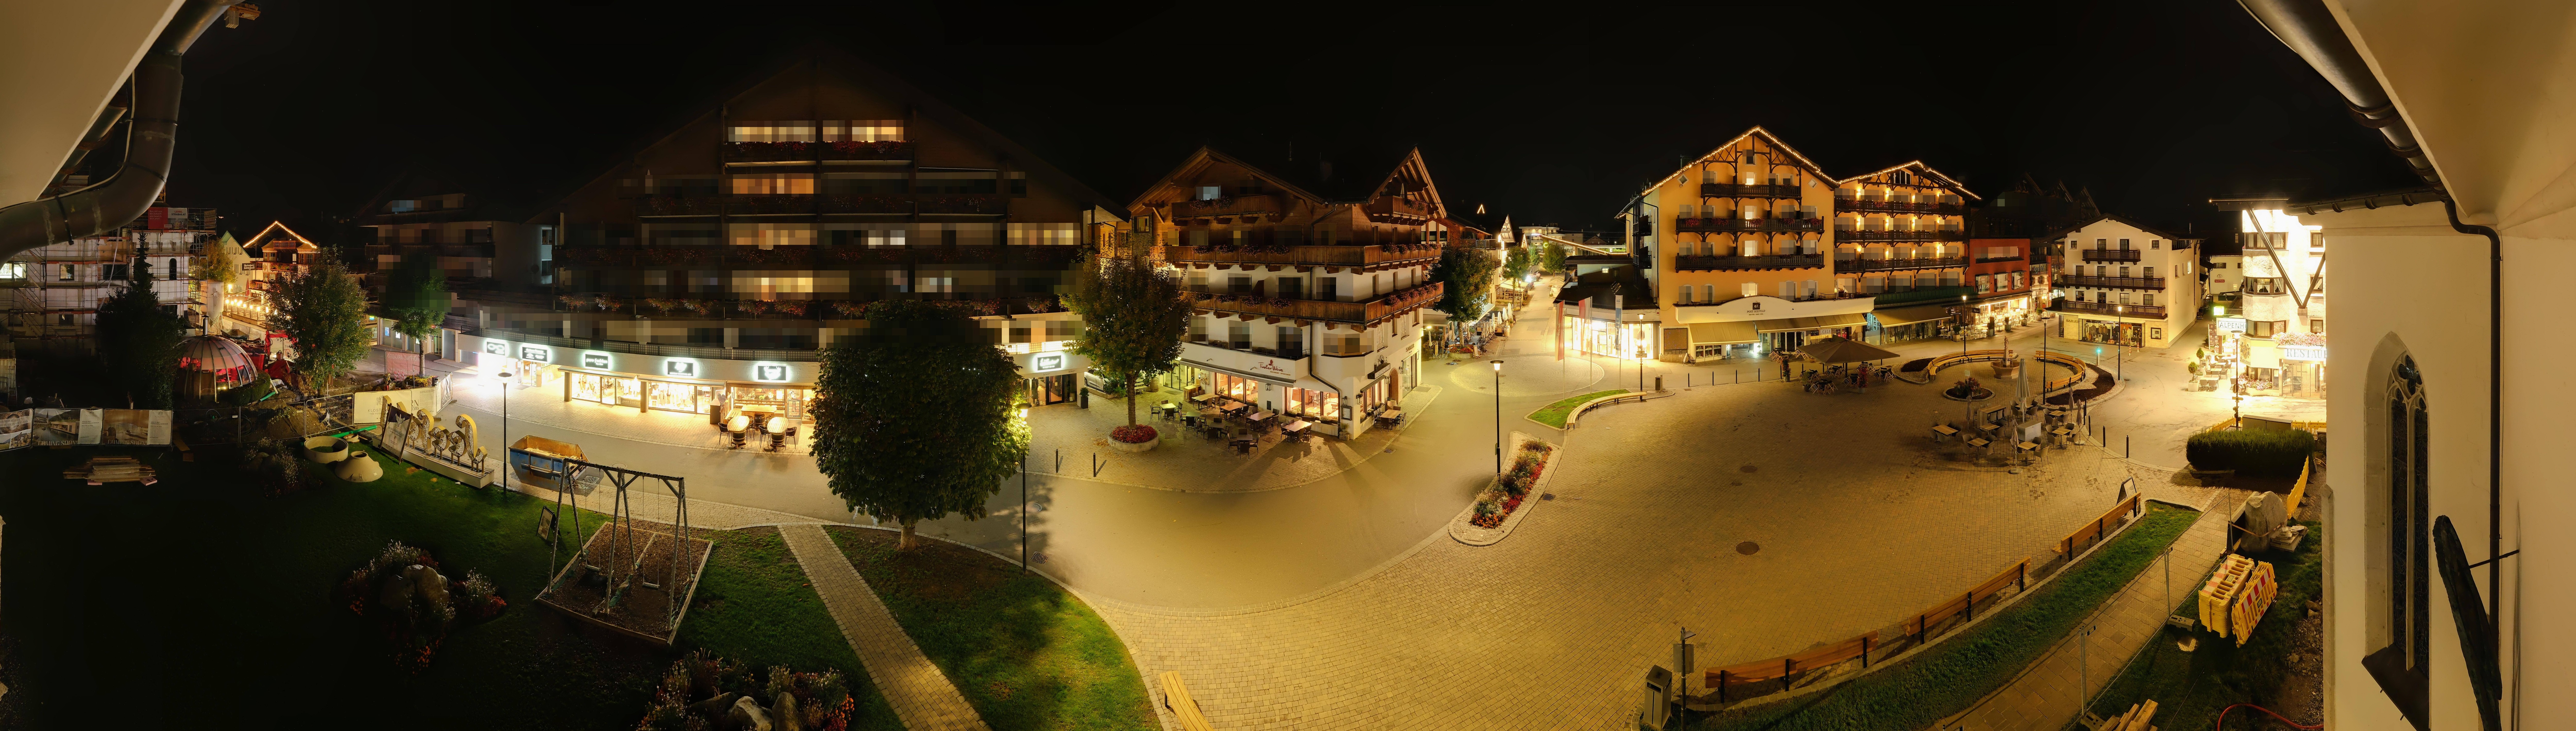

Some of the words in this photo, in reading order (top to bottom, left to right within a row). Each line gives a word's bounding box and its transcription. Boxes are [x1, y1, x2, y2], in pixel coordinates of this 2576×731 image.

[1406, 344, 1414, 352] SAILER
[2240, 356, 2251, 366] Kaltschmid
[1375, 365, 1390, 378] RESTAURANT
[388, 426, 401, 435] DEAFLYMPICS
